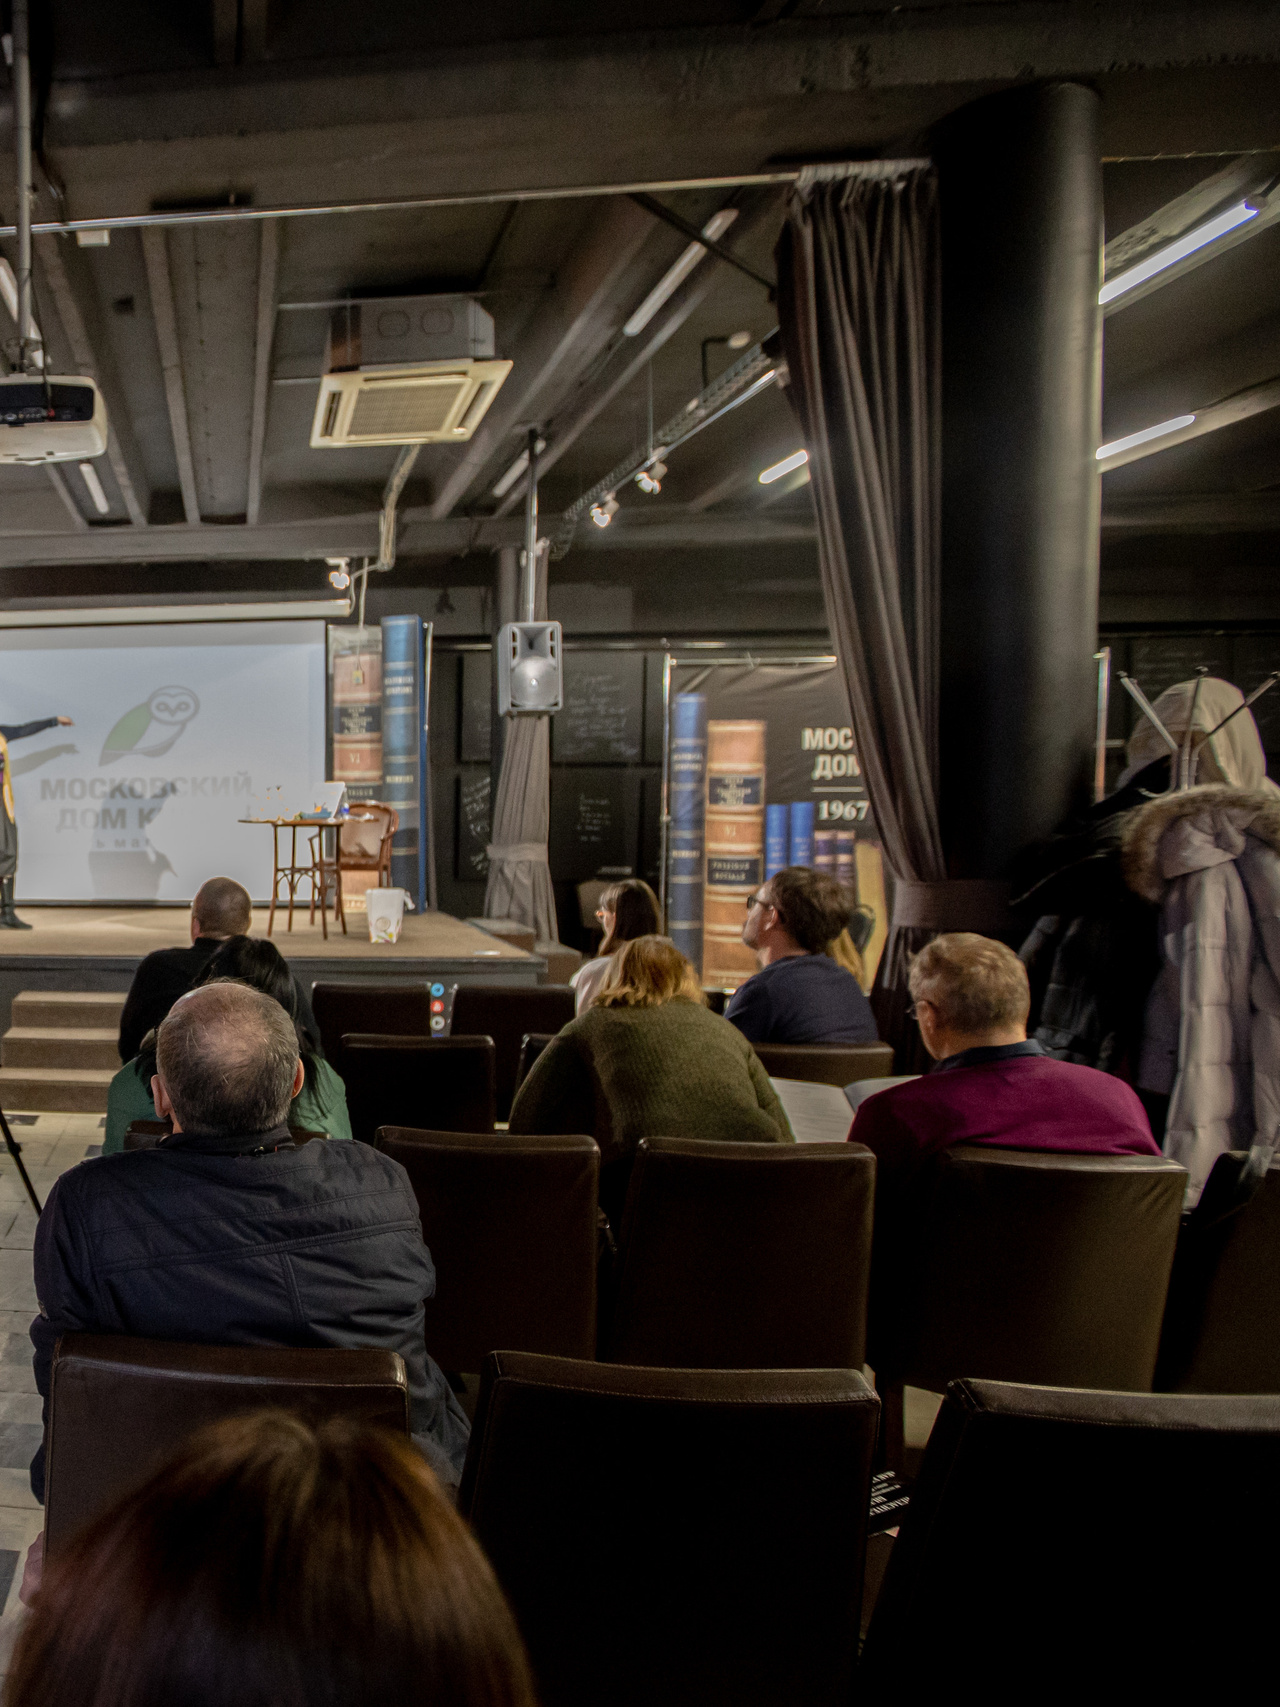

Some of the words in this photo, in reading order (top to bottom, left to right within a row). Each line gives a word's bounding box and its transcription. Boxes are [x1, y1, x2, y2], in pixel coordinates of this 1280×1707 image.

[40, 770, 254, 801] МОСКОВСКИЙ
[56, 807, 127, 832] ДОМ
[819, 800, 870, 821] 1967
